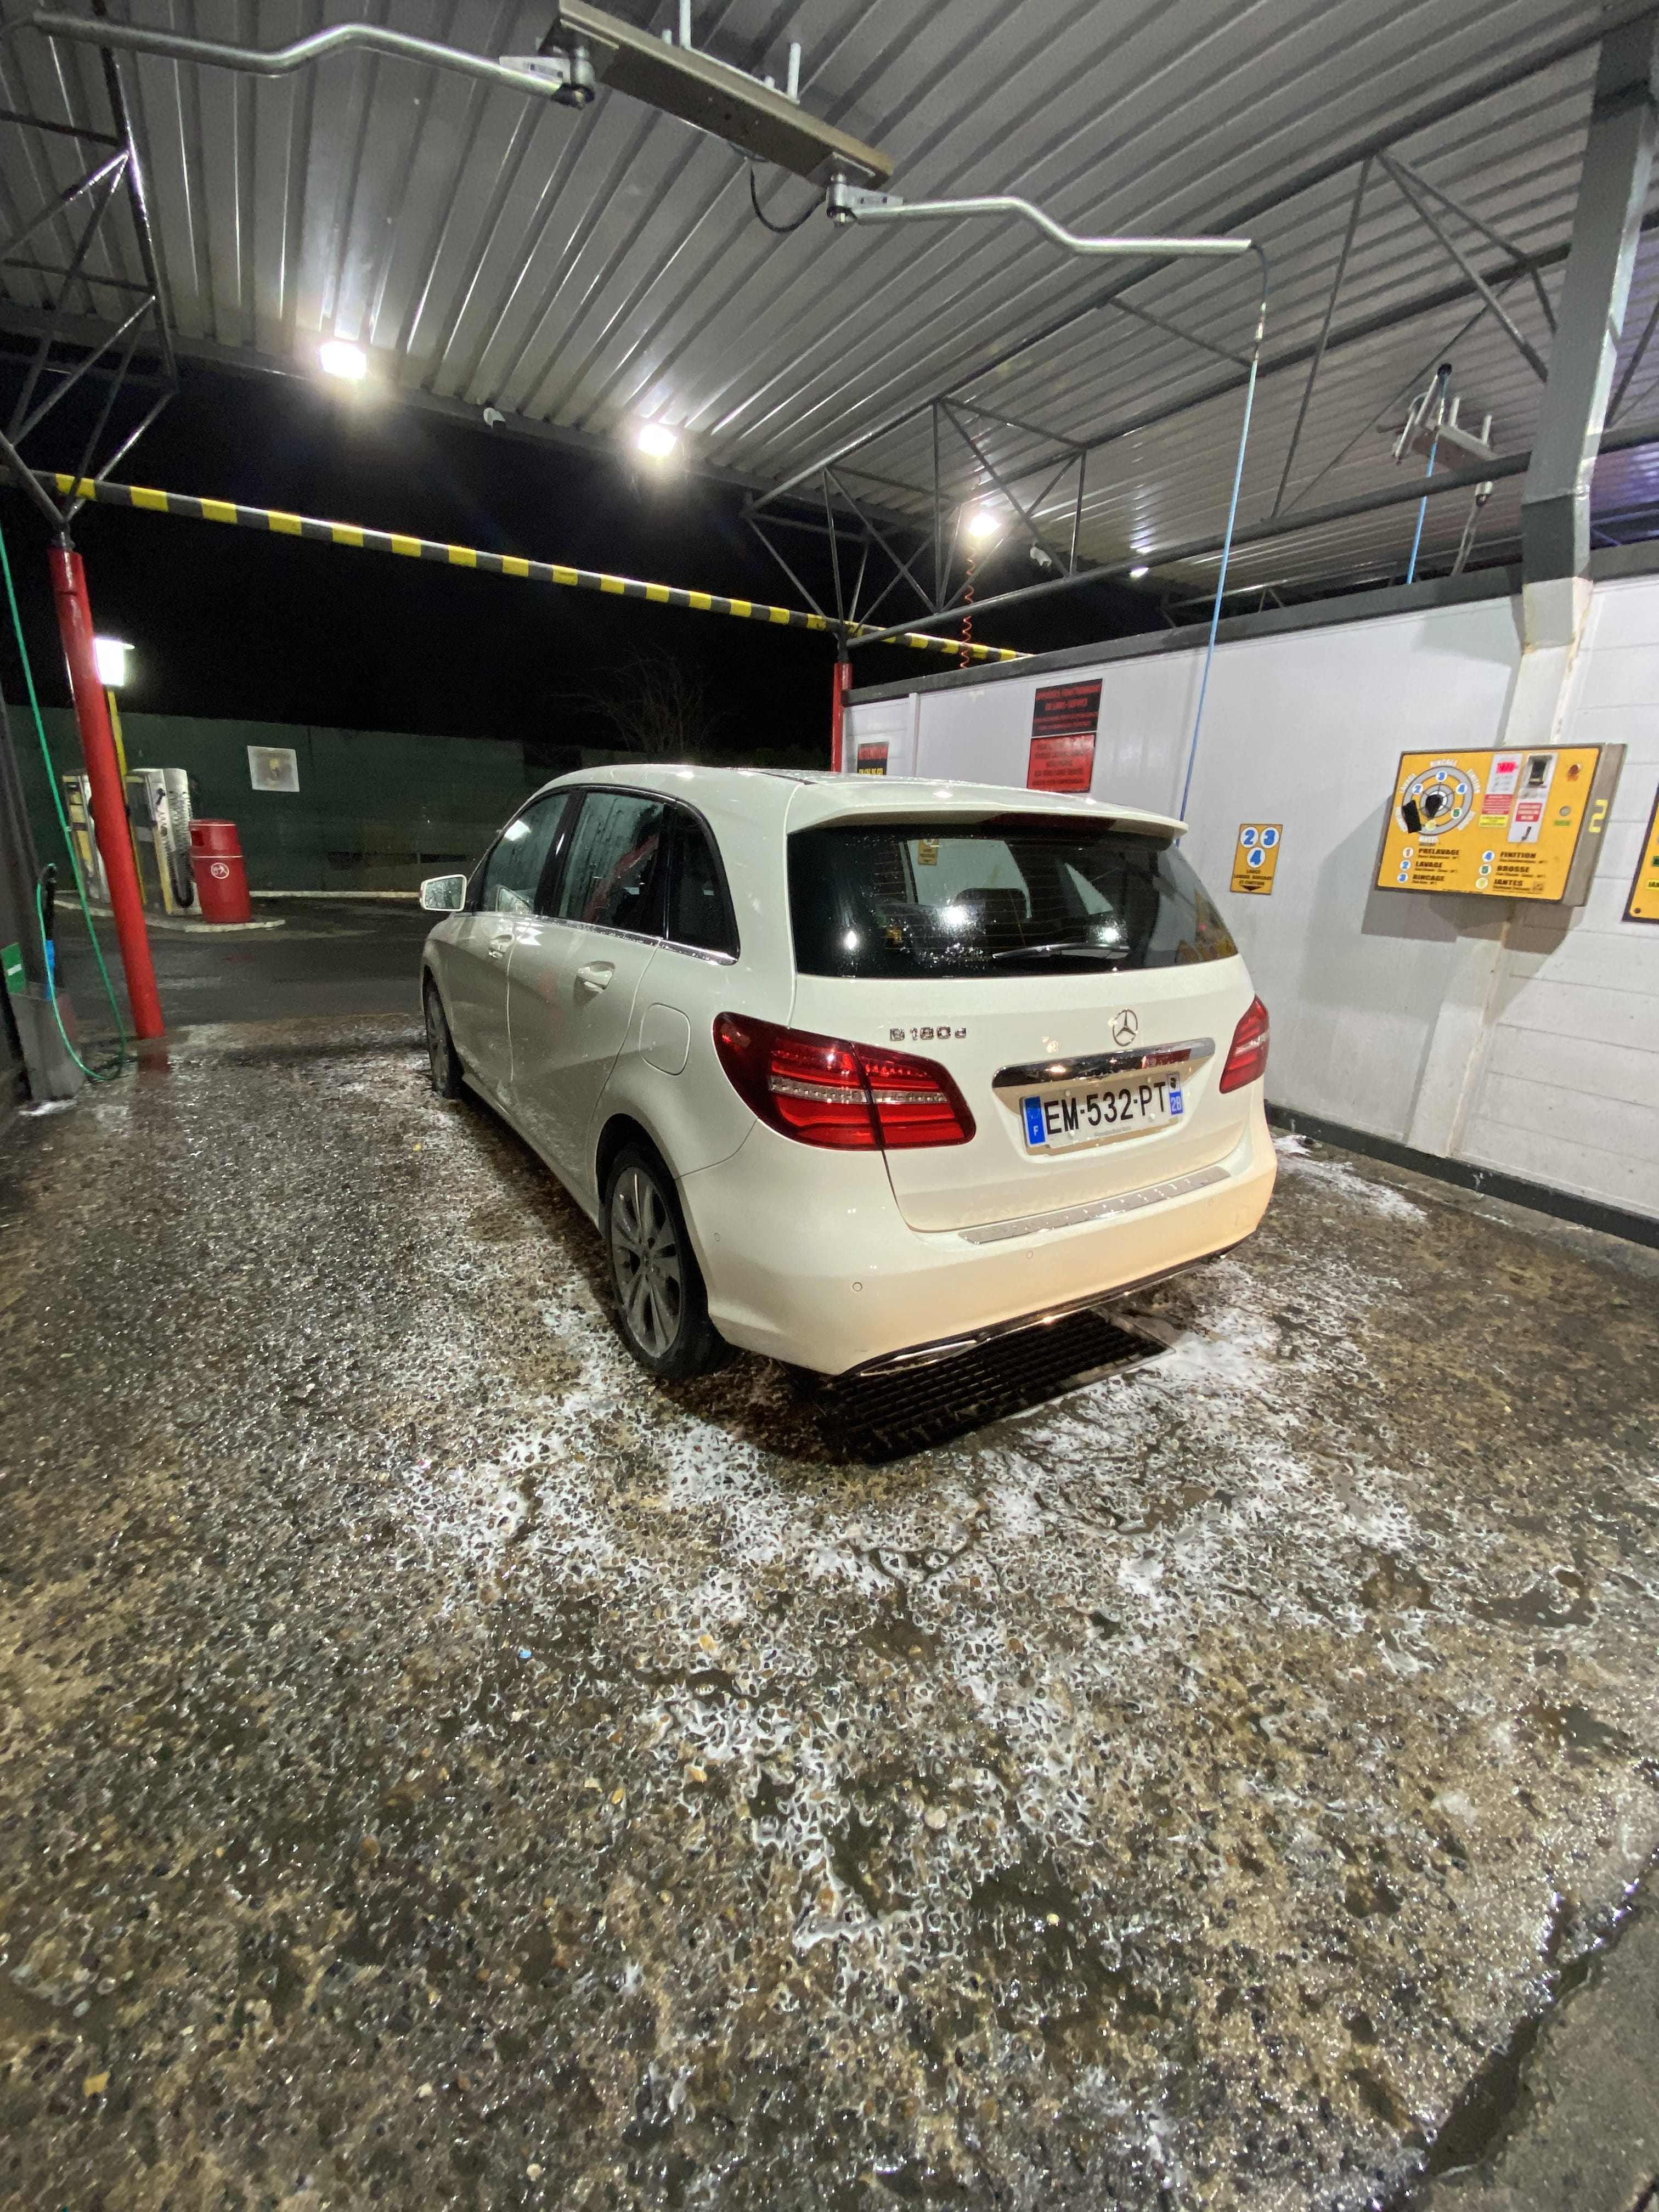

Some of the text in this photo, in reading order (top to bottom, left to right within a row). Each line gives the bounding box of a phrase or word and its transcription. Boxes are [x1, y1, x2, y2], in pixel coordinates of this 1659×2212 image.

[1439, 771, 1446, 781] 3
[1414, 785, 1421, 793] 2
[1458, 784, 1466, 793] 4
[1589, 799, 1608, 833] 2
[1244, 830, 1276, 845] 2 3
[1405, 848, 1411, 856] 1
[1485, 851, 1492, 860] 4
[1250, 850, 1261, 865] 4
[1481, 865, 1489, 874] 5
[1399, 874, 1406, 882] 3
[1044, 1082, 1166, 1135] EM-532-PT
[1033, 1125, 1039, 1136] F
